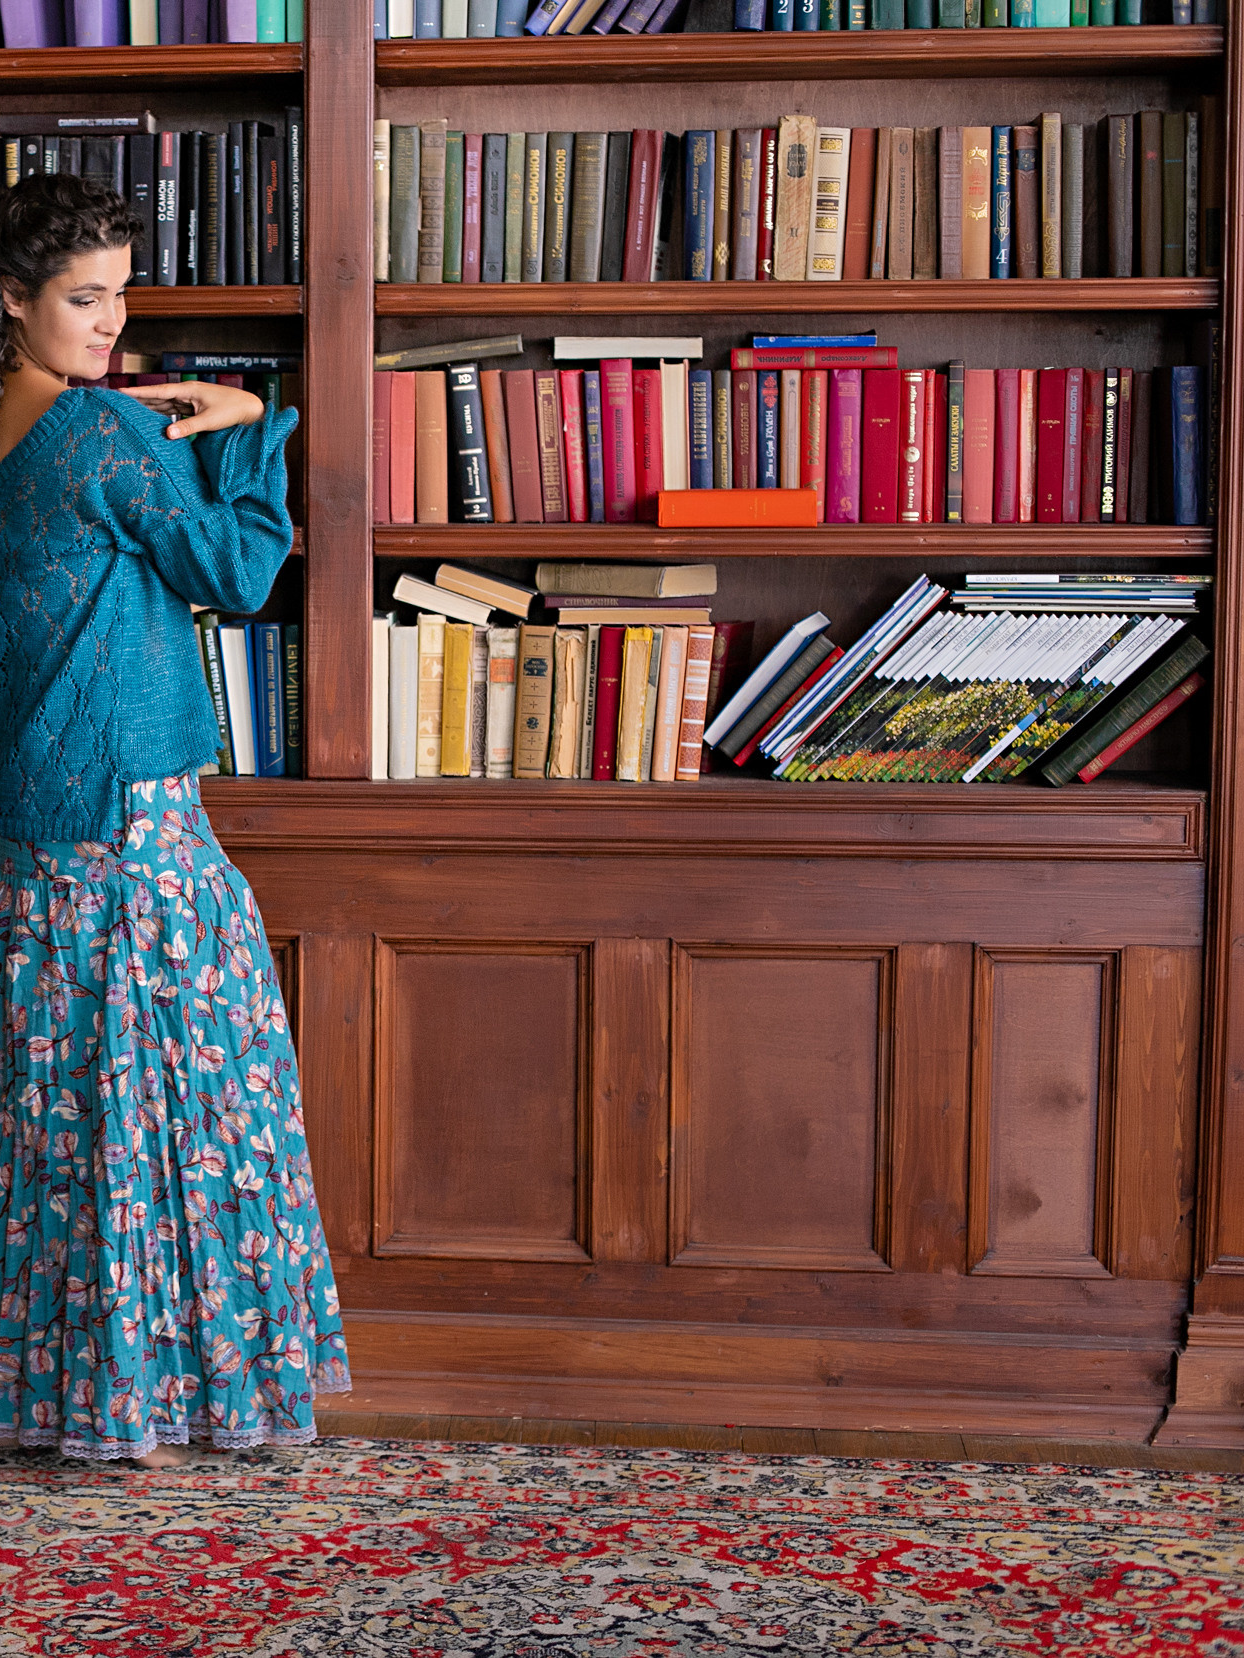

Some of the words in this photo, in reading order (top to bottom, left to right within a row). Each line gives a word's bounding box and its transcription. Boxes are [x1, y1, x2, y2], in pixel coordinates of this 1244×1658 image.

[777, 0, 789, 14] 2
[802, 0, 814, 14] 3
[6, 143, 18, 168] СТРАХА
[291, 124, 299, 183] ОРФОГРАФИЧЕСКИЙ
[466, 151, 478, 168] ДОН
[720, 144, 730, 188] ШАМЯКИН
[765, 139, 775, 164] ОУТС
[528, 149, 540, 205] СИМОНОВ
[553, 149, 566, 204] СИМОНОВ
[158, 179, 166, 213] САМОМ
[167, 179, 176, 221] ГЛАВНОМ
[720, 188, 729, 211] ИВАН
[526, 204, 538, 258] Константин
[551, 204, 564, 258] Константин
[996, 248, 1008, 265] 4
[195, 356, 228, 367] ГОЛОН
[756, 355, 803, 363] МАРИНИНА
[692, 381, 707, 445] МЕРЕЖКОВСКИЙ
[1070, 385, 1078, 412] ОХОТЫ
[463, 403, 474, 434] ЦУСИМА
[717, 388, 728, 443] СИМОНОВ
[740, 402, 750, 456] УЛЬЯНОВЫ
[765, 410, 775, 439] ГОЛОН
[950, 405, 960, 437] ЗАКУСКИ
[1069, 412, 1077, 445] ПРАВИЛА
[1105, 409, 1115, 442] КЛИМОВ
[568, 404, 584, 464] НАБАТ
[720, 443, 729, 488] онстантин
[950, 443, 959, 472] САЛАТЫ
[1105, 444, 1114, 484] ГРИГОРИЙ
[564, 597, 619, 606] СПРАВОЧНИК
[204, 628, 216, 661] УМЫТАЯ
[266, 631, 274, 651] ЯЗЫКУ
[899, 624, 930, 655] БОТТИЧЕЛЛИ
[952, 628, 969, 645] СЕРОВ
[953, 624, 982, 653] КАРАВАДЖО
[1060, 628, 1085, 652] БРЮЛЛОВ
[1080, 628, 1104, 650] СУРИКОВ
[1108, 630, 1137, 657] КУСТОДИЕВ
[1125, 628, 1152, 653] ВАСНЕЦОВ
[1153, 634, 1167, 647] БОСХ
[266, 652, 274, 680] РУССКОМУ
[669, 640, 681, 665] ШОССЕ
[210, 661, 221, 693] КРОВЬЮ
[268, 681, 275, 689] ПО
[215, 694, 226, 725] РОССИЯ
[664, 665, 679, 725] ВОЛОКОЛАМСКОЕ
[1138, 702, 1170, 730] НАВСТРЕЧУ
